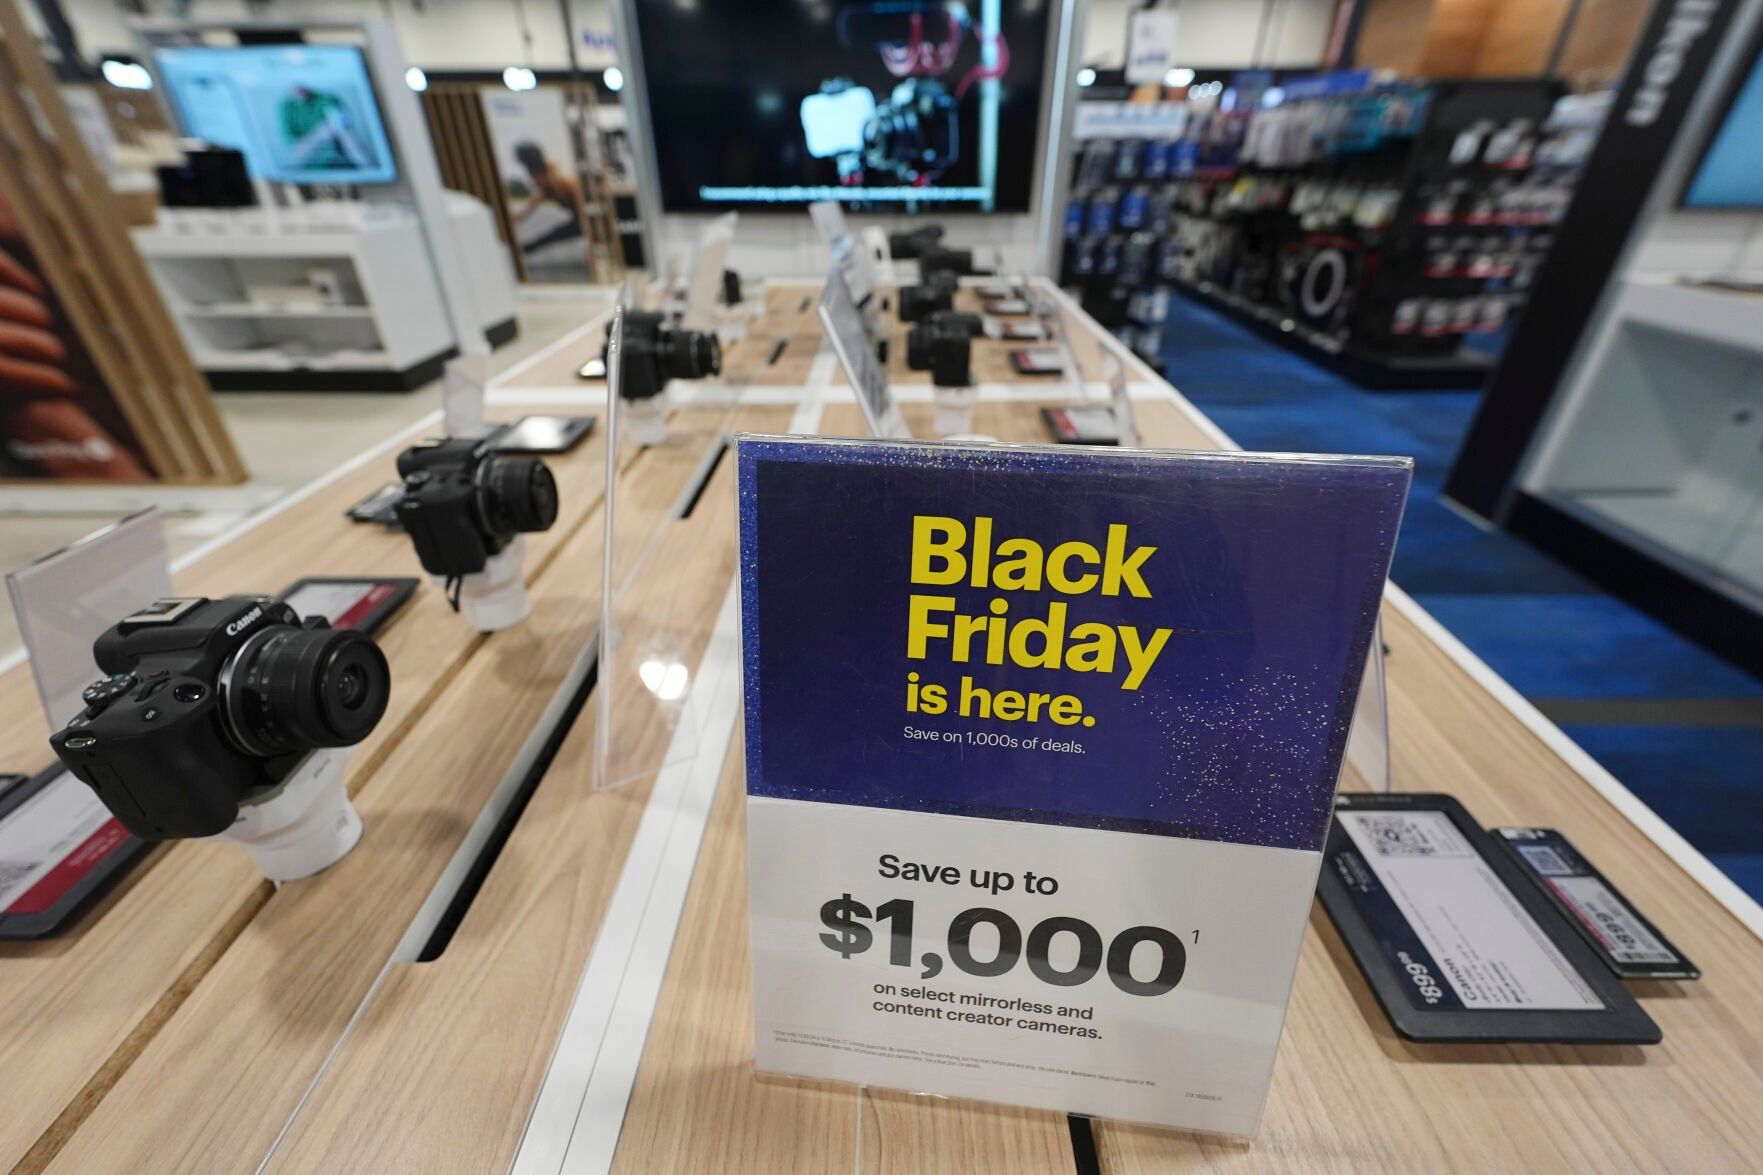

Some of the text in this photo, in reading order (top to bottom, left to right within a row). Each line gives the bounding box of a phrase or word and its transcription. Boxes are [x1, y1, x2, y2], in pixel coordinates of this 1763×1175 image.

[911, 515, 1158, 598] Black
[226, 606, 262, 636] Canon
[907, 594, 1174, 690] Friday
[906, 671, 1096, 728] is here.
[903, 726, 1086, 754] Save on 1,000s of deals.
[878, 854, 1059, 895] Save up to
[818, 893, 1187, 997] $1,000
[872, 999, 1103, 1041] content creator cameras.
[873, 983, 1094, 1020] on select mirrorless and
